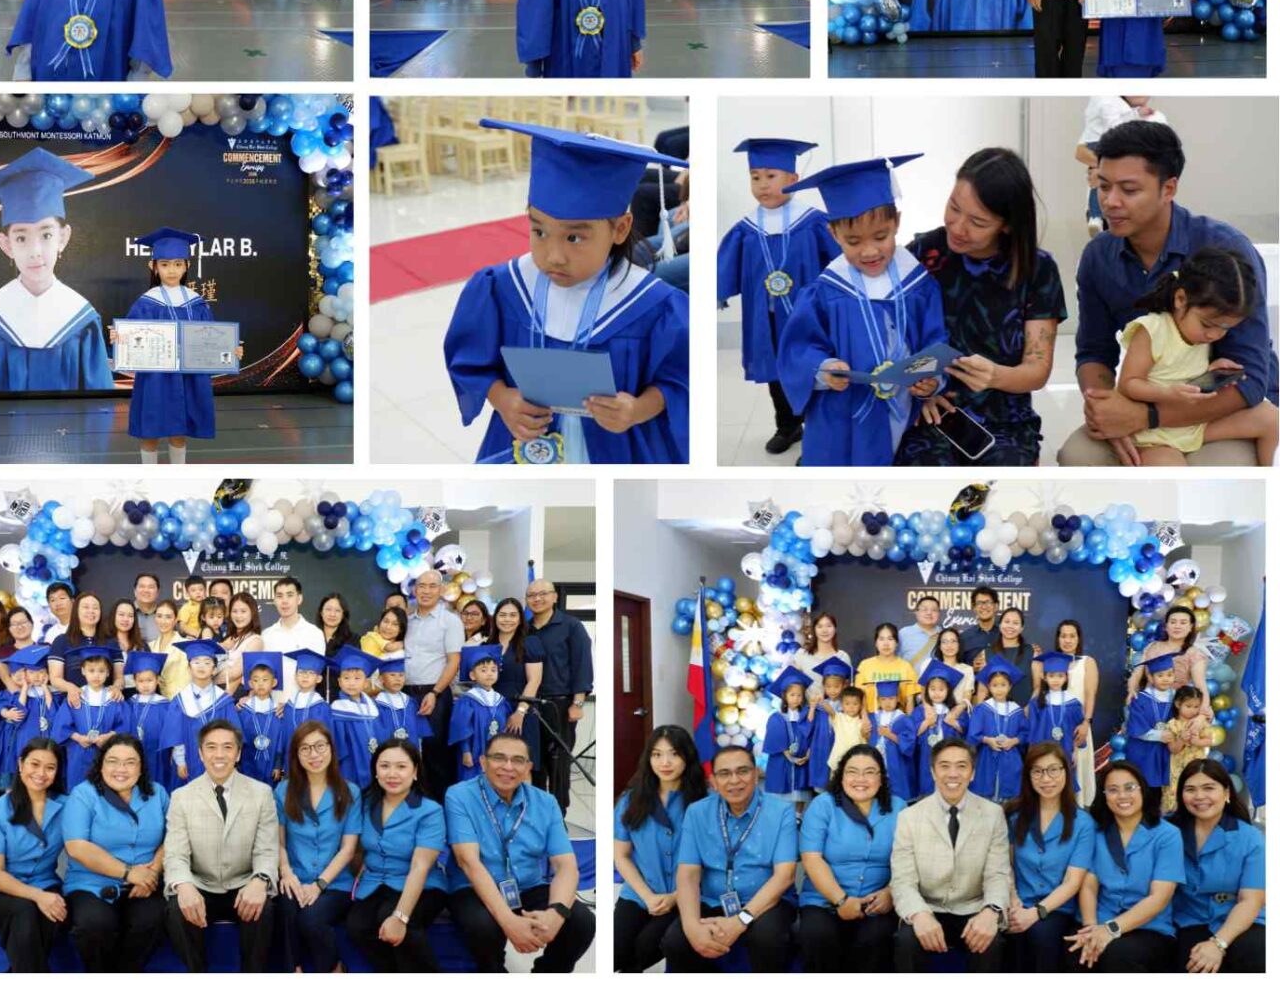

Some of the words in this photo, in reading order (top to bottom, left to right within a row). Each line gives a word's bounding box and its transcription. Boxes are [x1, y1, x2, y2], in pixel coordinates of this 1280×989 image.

[0, 131, 39, 139] SOUTHMONT
[41, 132, 82, 140] MONTESSORI
[223, 152, 282, 163] COMMENCEMENT
[189, 238, 235, 257] YLAR
[240, 238, 257, 256] B.
[997, 573, 1023, 585] College
[943, 608, 979, 629] Exerci
